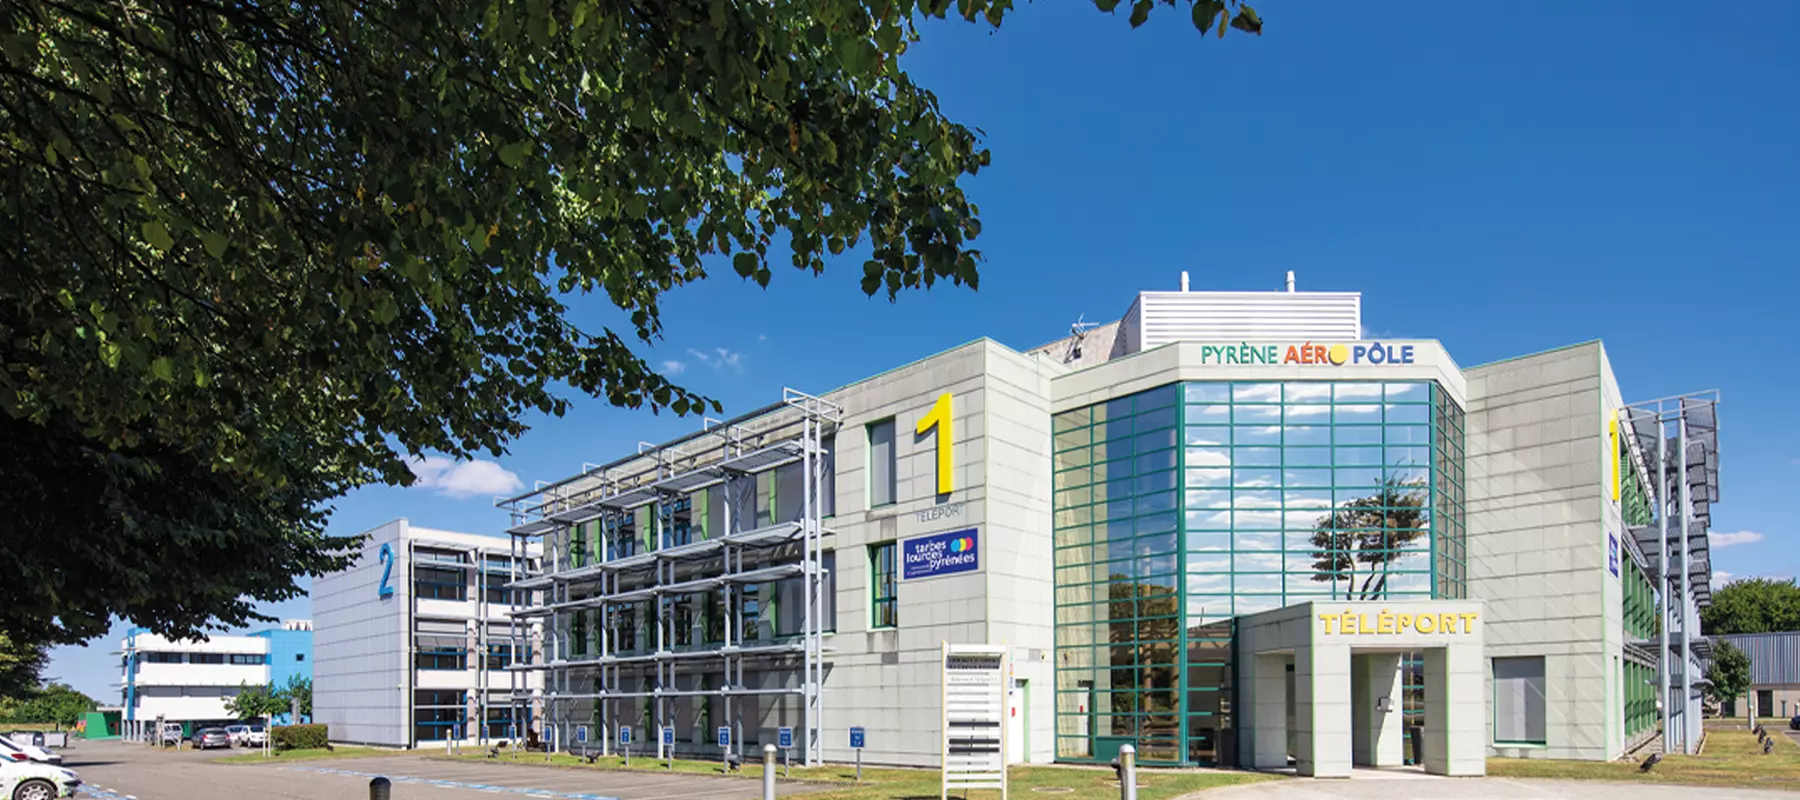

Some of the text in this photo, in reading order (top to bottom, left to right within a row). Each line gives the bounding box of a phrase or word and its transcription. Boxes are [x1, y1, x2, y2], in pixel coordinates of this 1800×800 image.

[1201, 341, 1278, 364] PYRÈNE
[1353, 341, 1415, 364] PÔLE
[916, 392, 954, 496] 1
[915, 540, 947, 554] tarbes
[378, 542, 395, 597] 2
[1318, 608, 1479, 635] TÉLÉPORT
